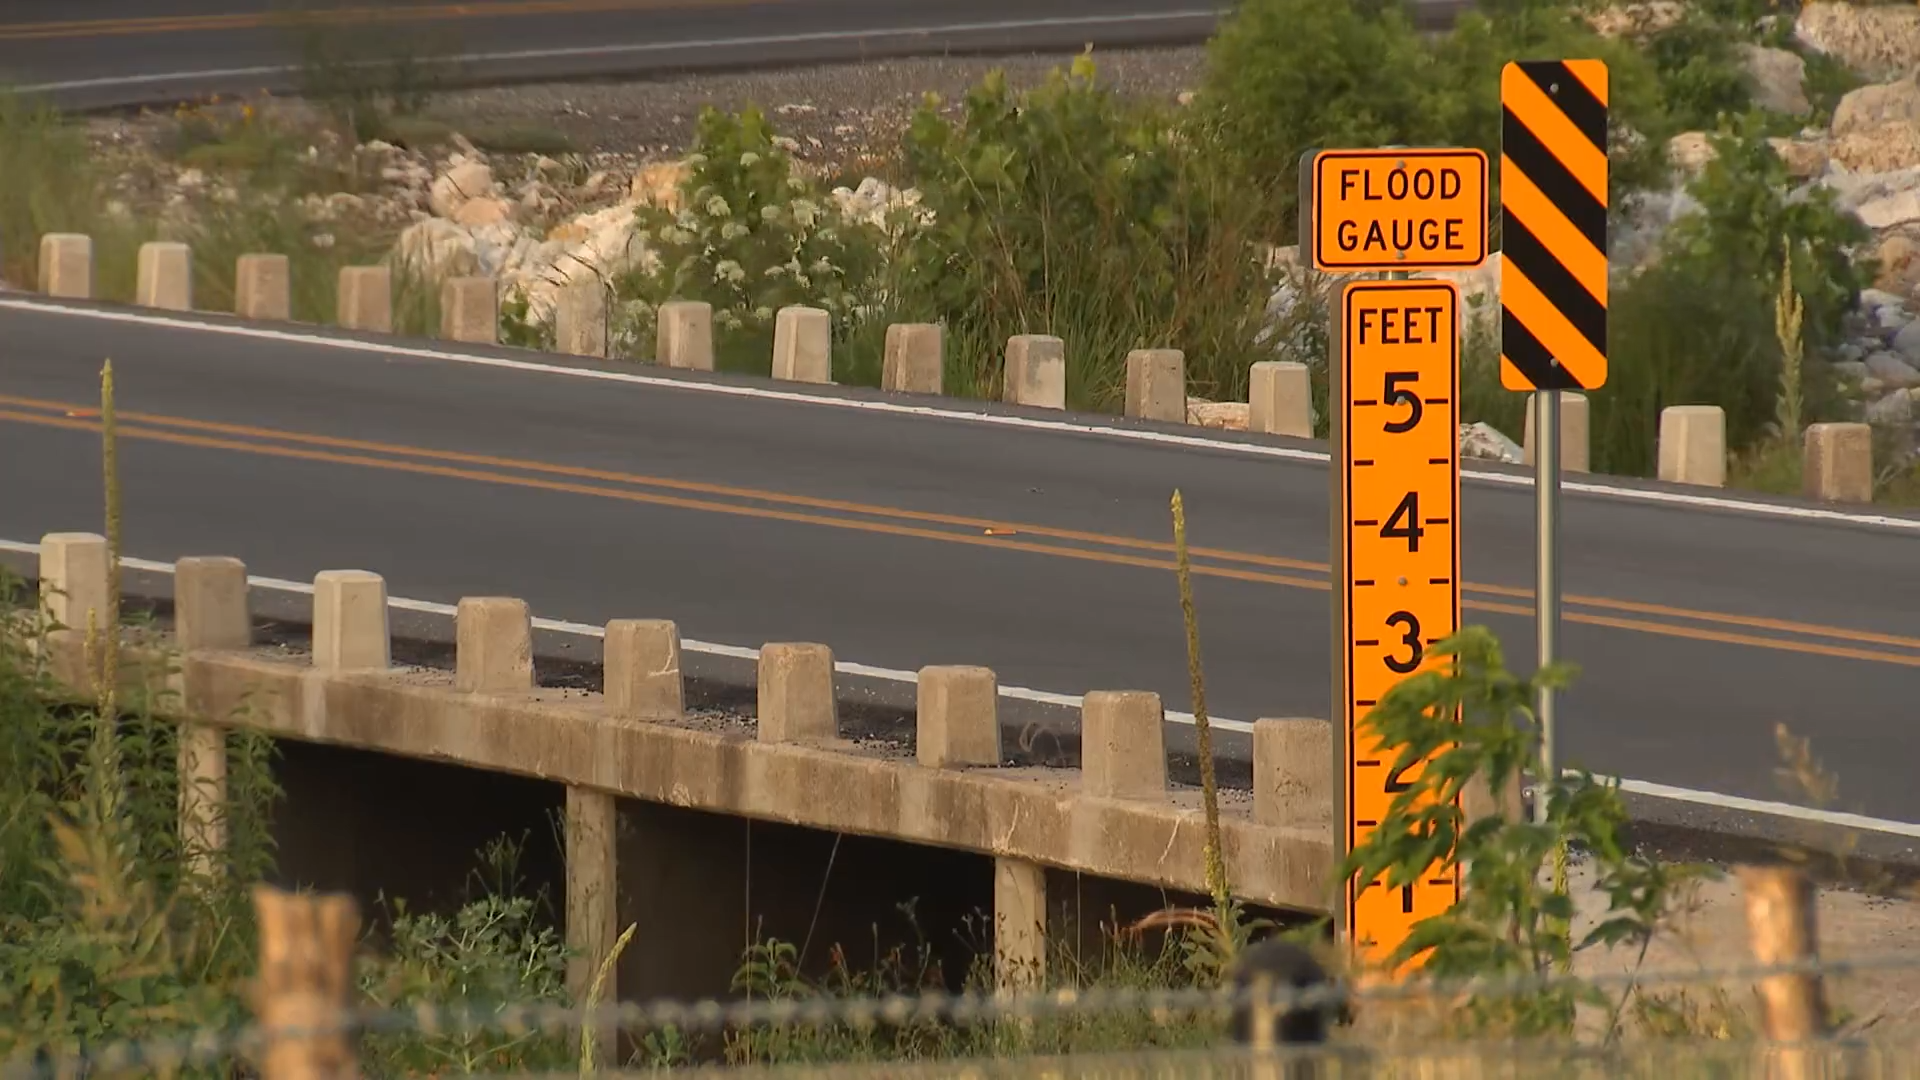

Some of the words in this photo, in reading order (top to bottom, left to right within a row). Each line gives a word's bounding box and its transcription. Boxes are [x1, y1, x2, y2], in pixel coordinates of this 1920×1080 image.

[1341, 168, 1461, 200] FLOOD
[1338, 219, 1464, 251] GAUGE
[1359, 308, 1442, 344] FEET
[1383, 372, 1422, 433] 5
[1379, 492, 1424, 552] 4
[1383, 611, 1423, 673] 3
